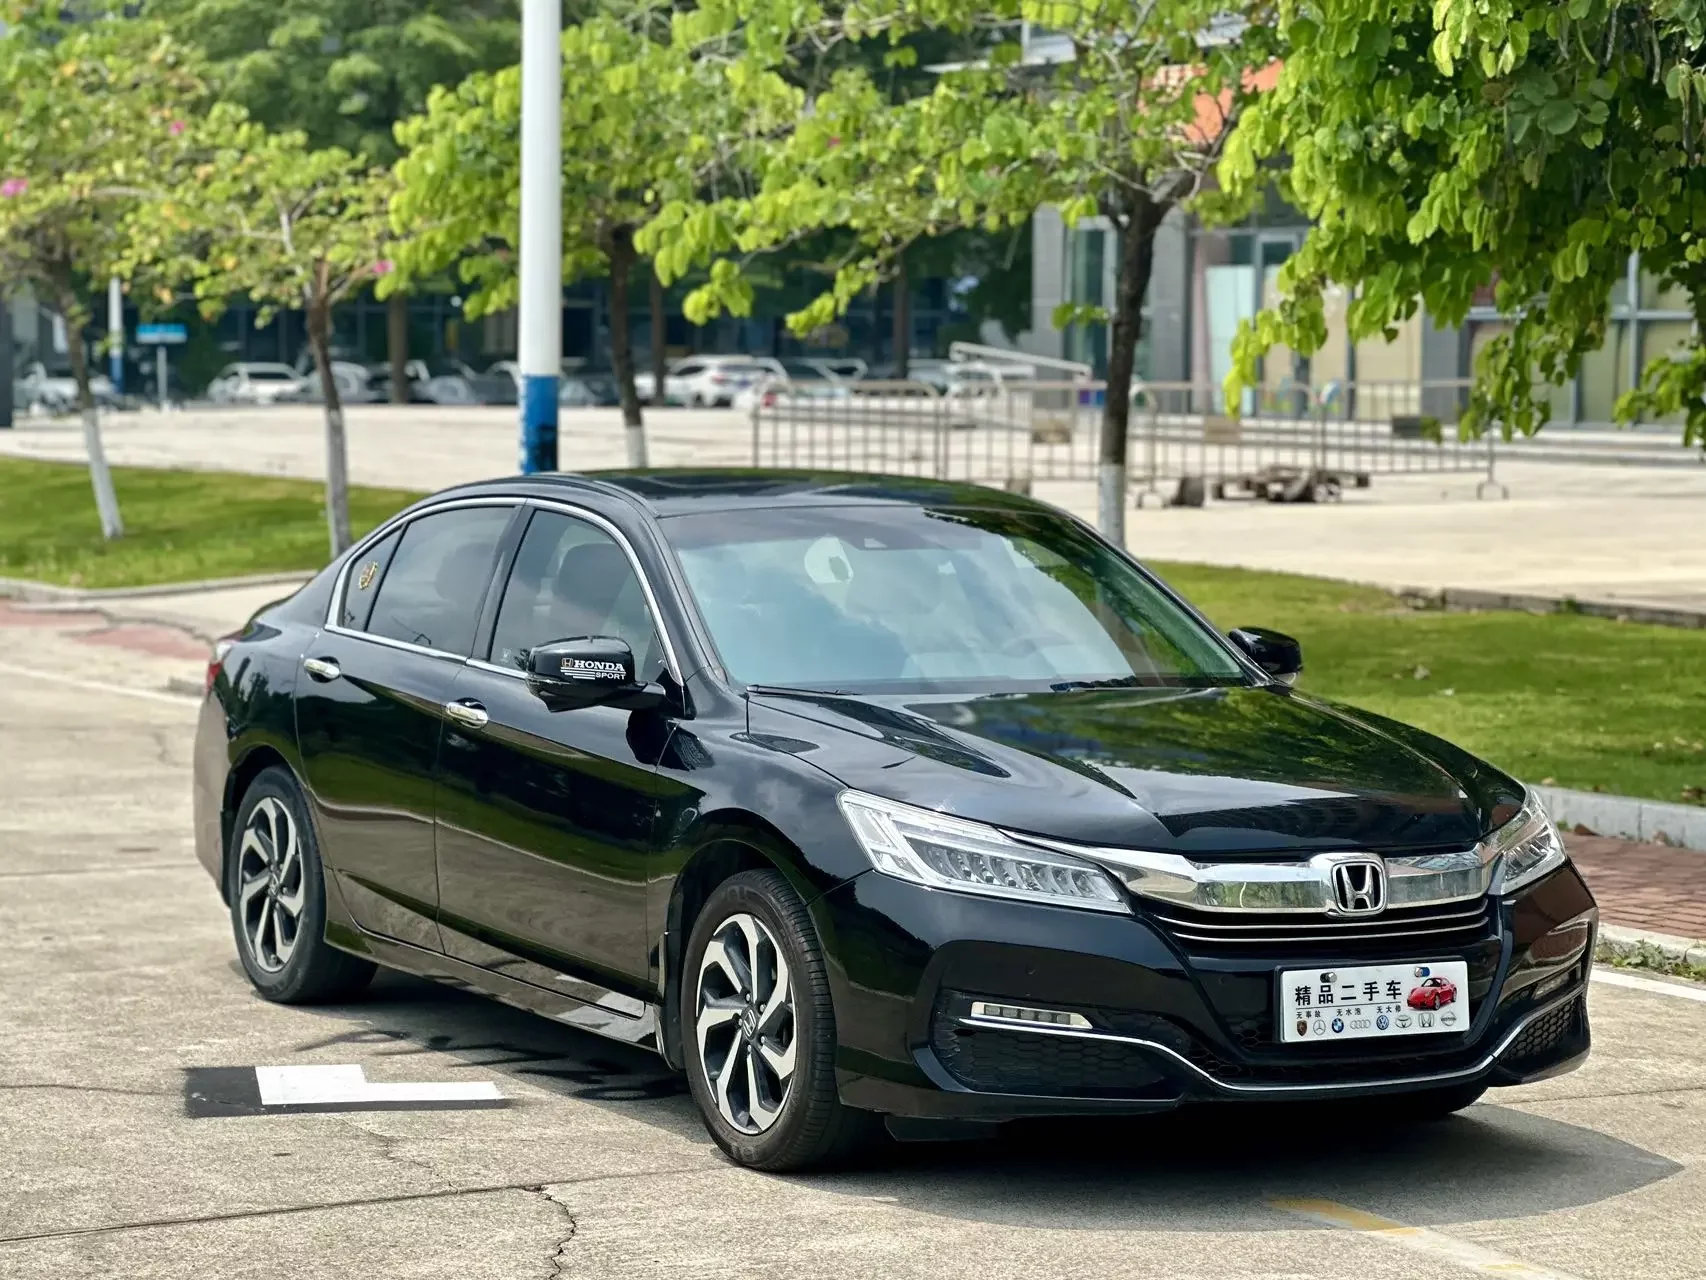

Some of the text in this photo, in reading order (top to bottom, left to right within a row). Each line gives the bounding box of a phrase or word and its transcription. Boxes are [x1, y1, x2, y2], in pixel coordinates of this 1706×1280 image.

[574, 659, 625, 672] HONDA
[595, 672, 627, 680] SPORT
[1295, 980, 1402, 1006] 精品二手车
[1296, 1010, 1321, 1019] 无事故
